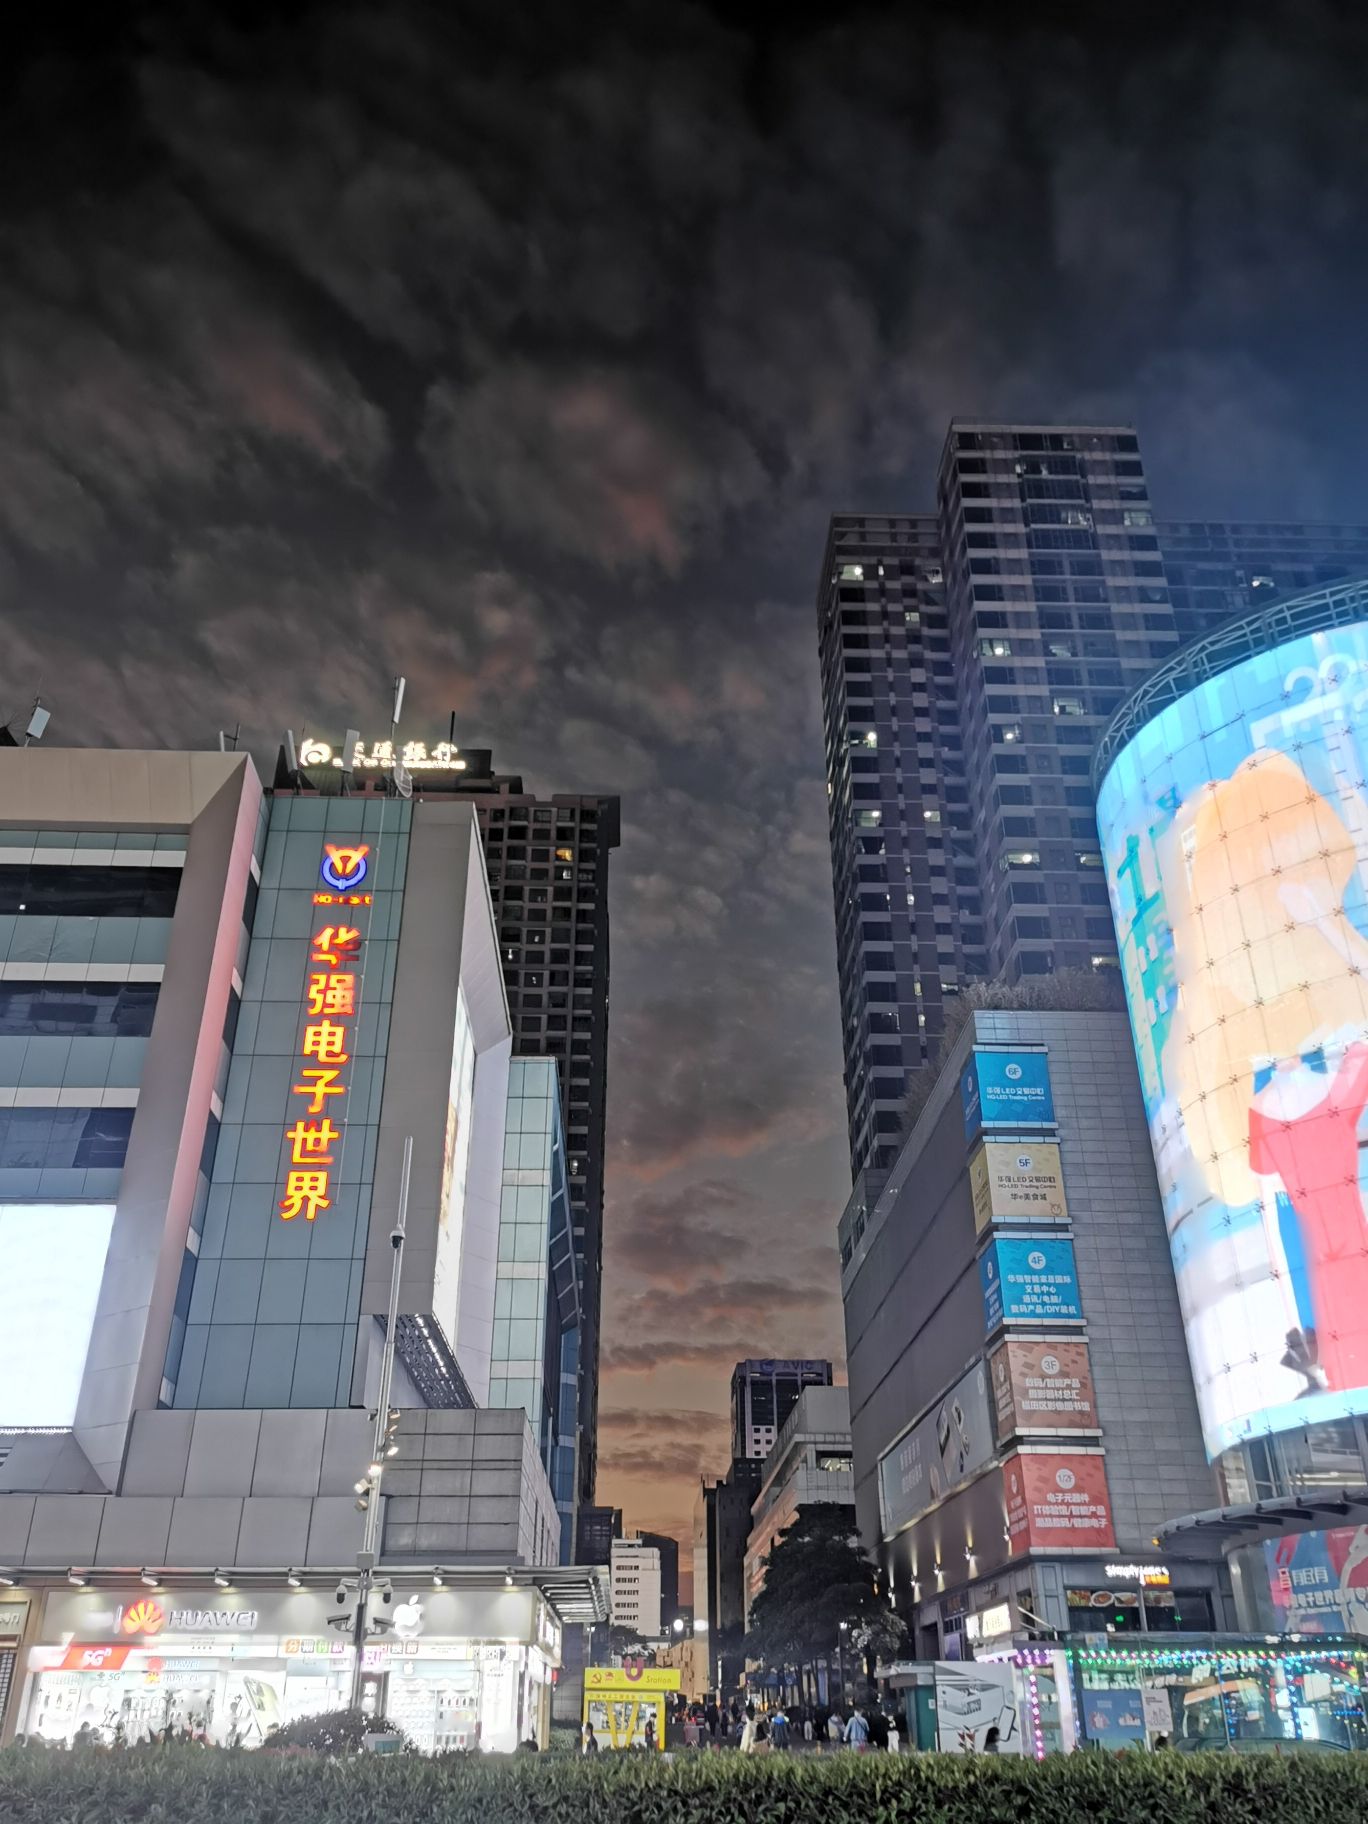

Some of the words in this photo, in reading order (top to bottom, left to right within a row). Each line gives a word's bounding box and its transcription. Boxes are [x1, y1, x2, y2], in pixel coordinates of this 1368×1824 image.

[279, 925, 363, 1221] 华强电子世界
[1008, 1067, 1020, 1076] 6F
[1018, 1158, 1031, 1168] 5F
[1031, 1255, 1044, 1265] 4F
[1043, 1360, 1057, 1371] 3F
[169, 1611, 257, 1630] HUAWEI
[646, 1675, 672, 1685] Station
